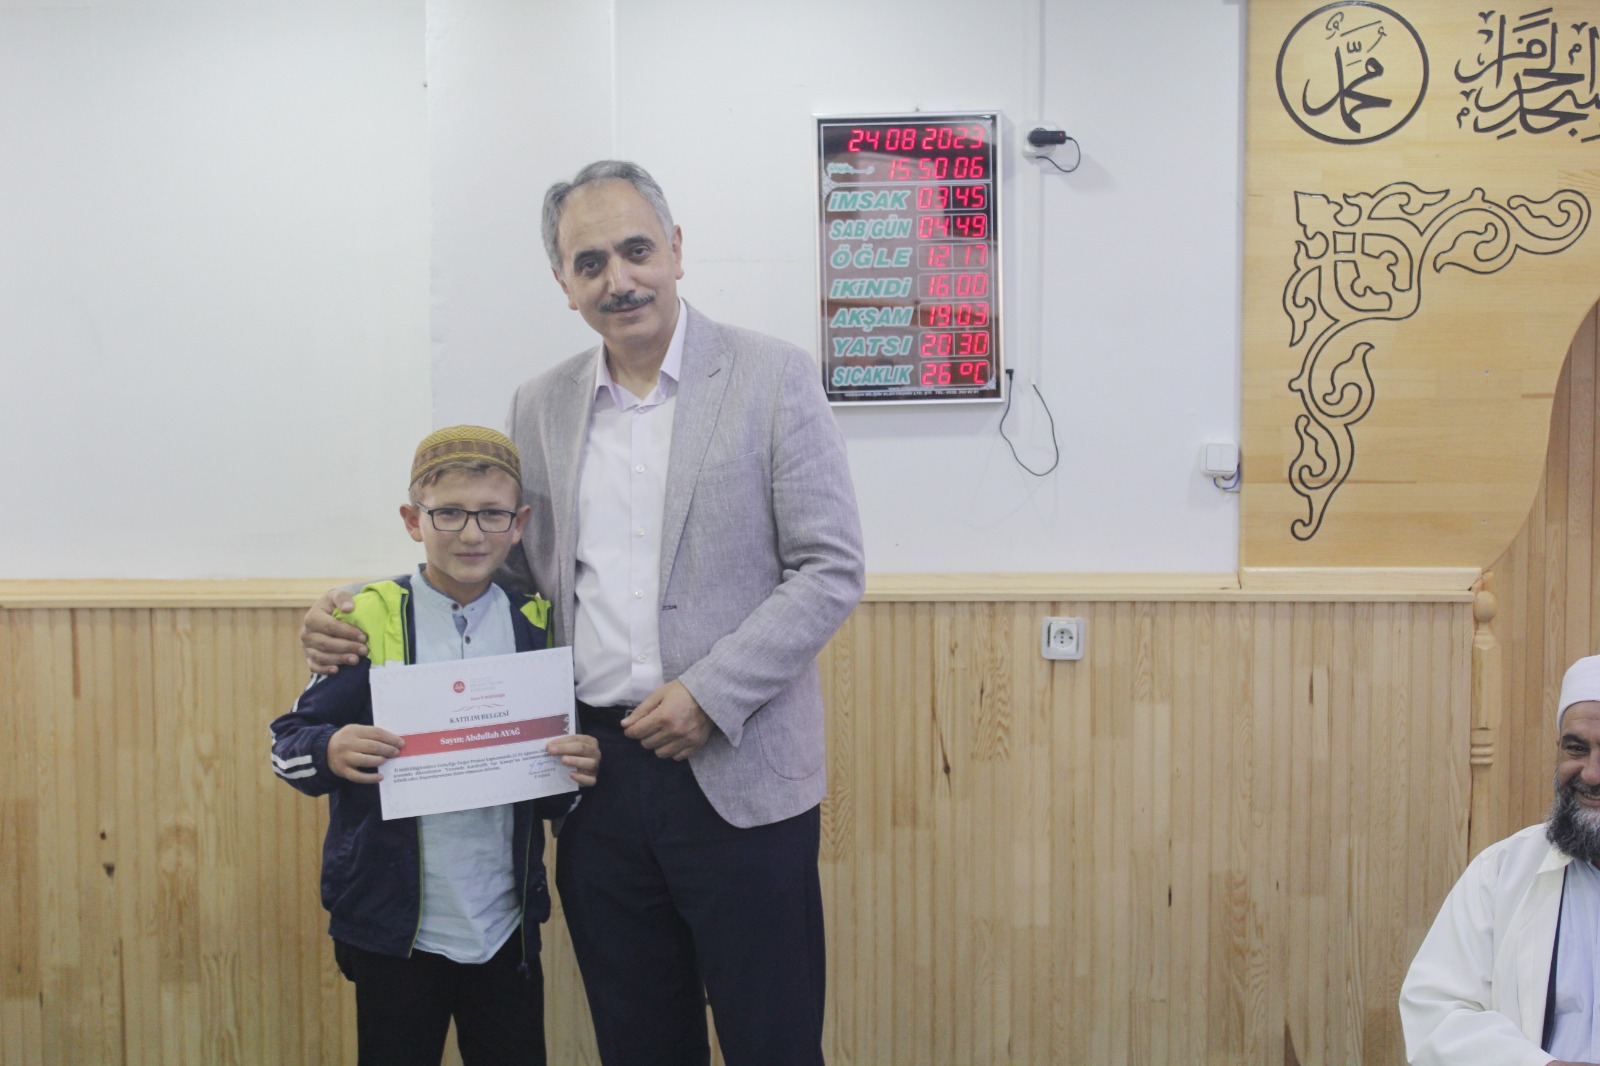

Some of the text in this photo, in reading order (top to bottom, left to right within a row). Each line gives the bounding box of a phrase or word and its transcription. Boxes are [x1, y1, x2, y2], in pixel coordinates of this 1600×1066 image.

[848, 126, 985, 152] 24 08 2023
[890, 156, 984, 181] 15 50 06
[918, 186, 949, 209] 03
[956, 185, 985, 208] 45
[831, 215, 986, 240] SAB/GÜN 04 49
[831, 244, 987, 268] ÖĞLE 12 17
[928, 274, 950, 297] 16
[956, 273, 987, 296] 00
[831, 303, 988, 331] AKŞAM 19 03
[833, 333, 988, 357] YATSI 20 30
[833, 366, 912, 386] SICAKLIK
[921, 363, 952, 386] 26
[449, 709, 509, 724] KATILIM BELGESİ
[465, 731, 499, 742] Abdullah
